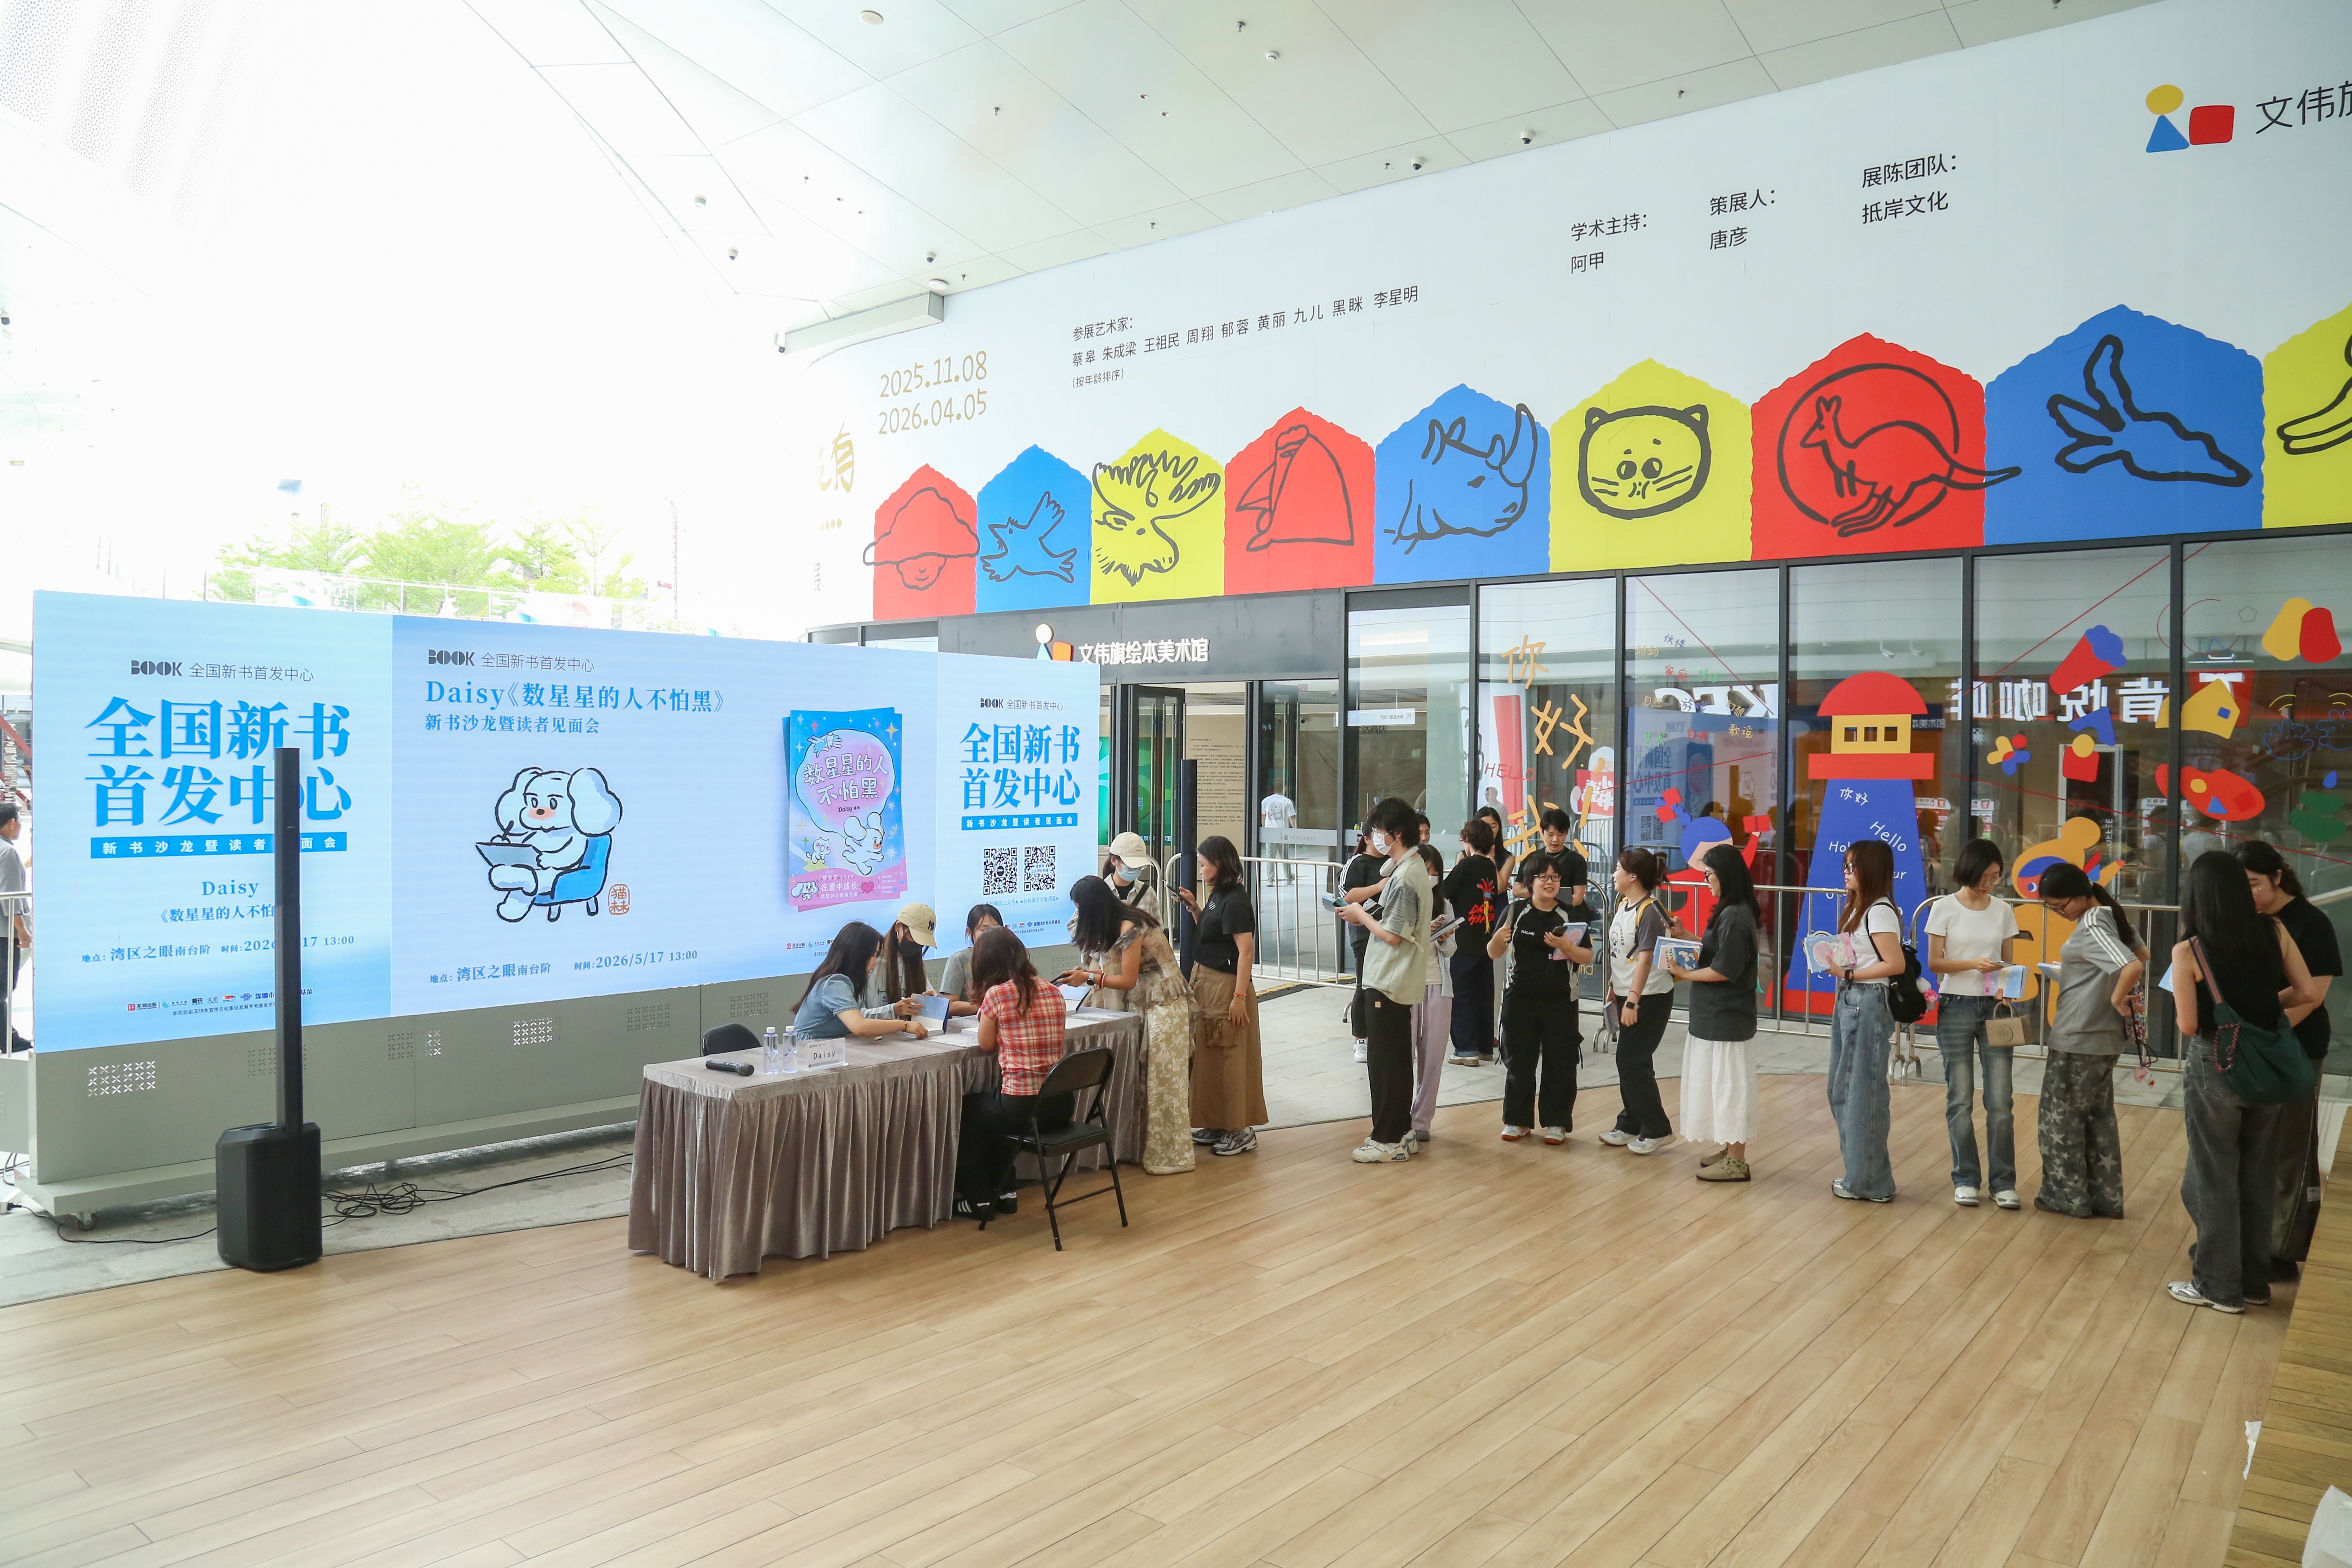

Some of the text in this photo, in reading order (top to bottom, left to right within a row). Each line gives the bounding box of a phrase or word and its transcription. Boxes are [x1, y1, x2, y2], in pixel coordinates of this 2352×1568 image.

[1862, 154, 1956, 188] 展陈团队：
[1710, 189, 1775, 216] 策展人：
[1862, 190, 1948, 224] 抵岸文化
[1570, 212, 1647, 241] 学术主持：
[1710, 226, 1747, 250] 唐彦
[1570, 252, 1604, 274] 阿甲
[1073, 316, 1133, 342] 参展艺术家：
[1102, 341, 1136, 361] 朱成梁
[1144, 332, 1179, 353] 王祖民
[1187, 327, 1214, 344] 周翔
[1221, 318, 1249, 338] 郁蓉
[1258, 311, 1285, 330] 黄丽
[1294, 305, 1323, 323] 九儿
[1333, 296, 1363, 317] 黑眯
[1374, 285, 1418, 308] 李星明
[880, 351, 987, 398] 2025.11.08
[1072, 368, 1123, 389] (按年龄排序)
[878, 388, 987, 435] 2026.04.05
[1078, 637, 1210, 666] 文伟旗绘本美术馆
[1664, 634, 1686, 649] 伙伴
[131, 660, 314, 682] BOOK 全国新书首发中心
[428, 649, 595, 673] BOOK 全国新书首发中心
[1665, 665, 1687, 682] 家庭
[980, 698, 1064, 712] BOOK 全国新书首发中心
[1644, 695, 1662, 708] 自然
[1726, 700, 1745, 717] 幻想
[85, 696, 350, 760] 全国新书
[425, 713, 600, 734] 新书沙龙暨读者见面会
[1728, 724, 1753, 738] 歌谣
[960, 722, 1080, 765] 全国新书
[1643, 732, 1666, 746] 艺术
[803, 753, 889, 786] 数星星的人
[1485, 763, 1535, 781] HELLO
[85, 764, 352, 826] 首发中心
[817, 777, 878, 806] 不怕黑
[960, 768, 1080, 810] 首发中心
[1840, 787, 1868, 806] 你好
[967, 816, 1073, 829] 新书沙龙暨读者见面会
[102, 837, 336, 855] 新书沙龙暨读者面会
[1870, 821, 1907, 852] Hello
[202, 879, 259, 899] Daisy
[821, 882, 858, 892] 在爱中成长
[324, 935, 354, 946] 13:00
[669, 950, 698, 962] 13:00
